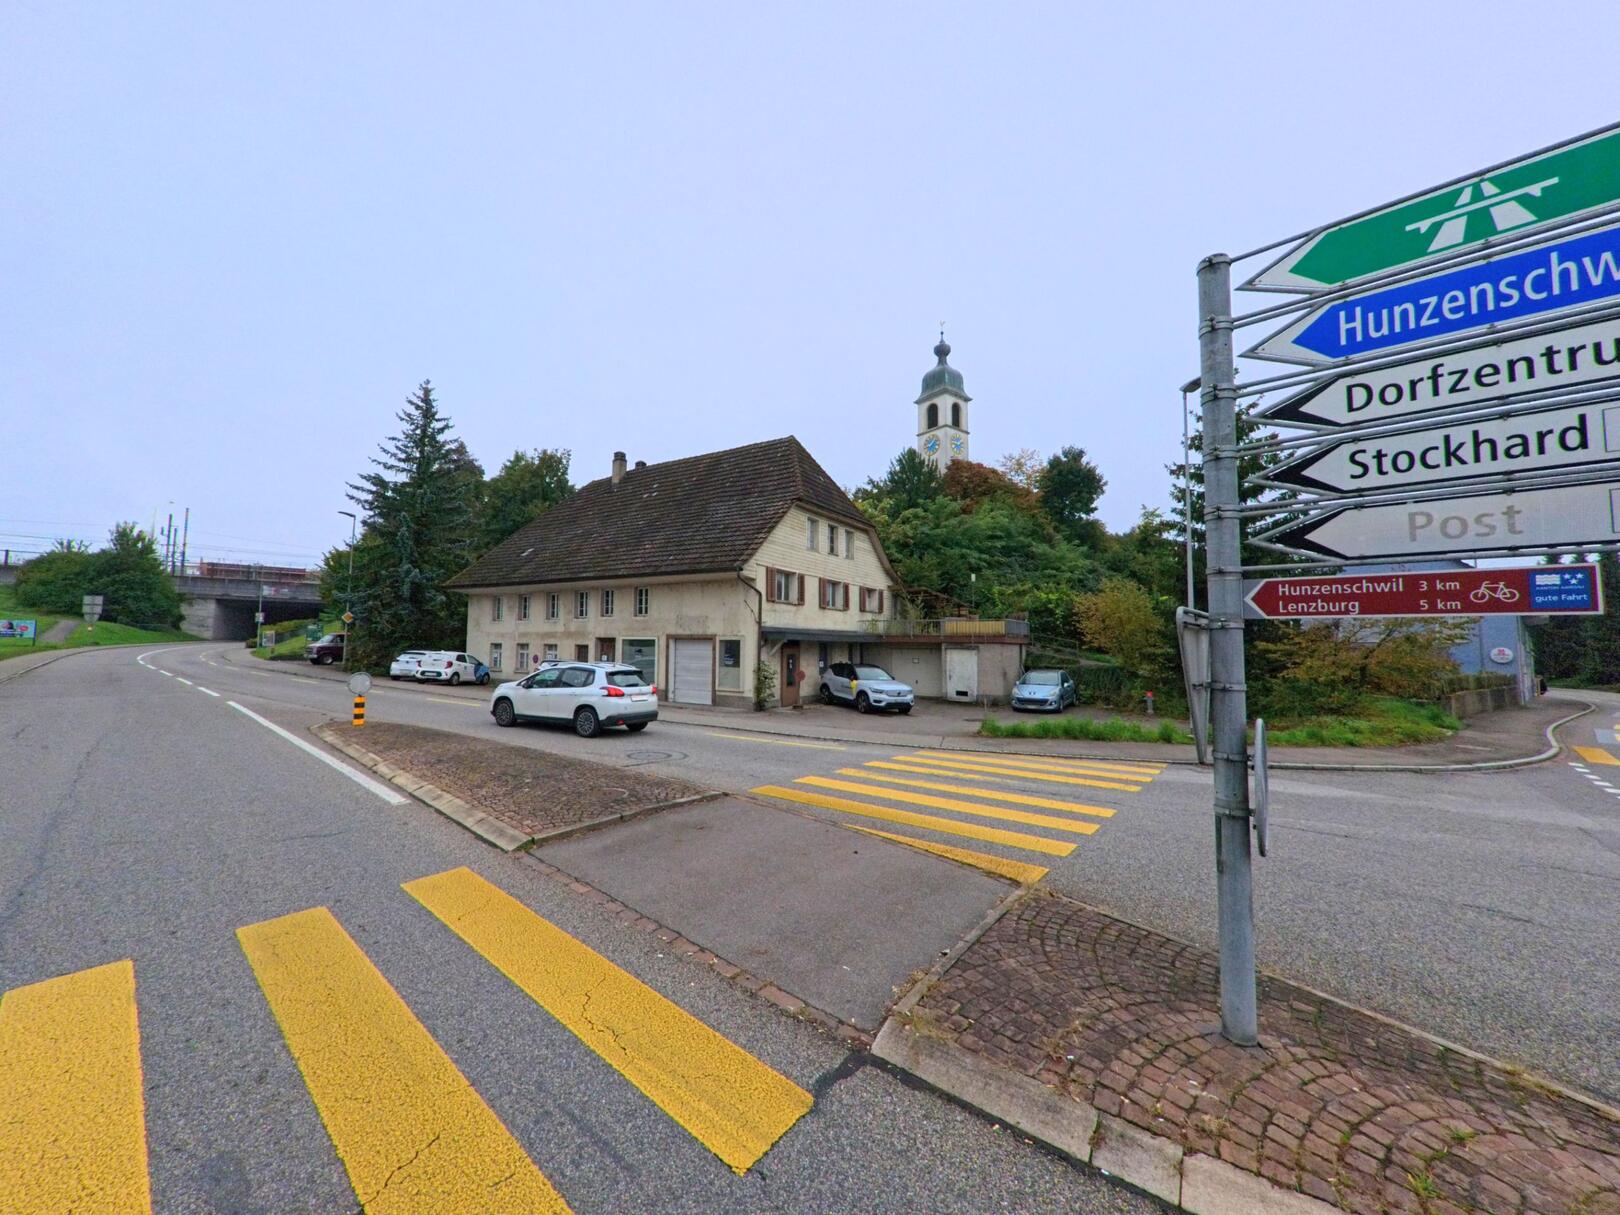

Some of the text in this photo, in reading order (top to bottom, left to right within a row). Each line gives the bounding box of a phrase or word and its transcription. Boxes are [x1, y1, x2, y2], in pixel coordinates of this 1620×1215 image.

[1346, 337, 1620, 413] Dorfzentru
[1348, 413, 1589, 480] Stockhard
[1407, 504, 1524, 542] Post
[1278, 578, 1460, 596] Hunzenschwil 3 km
[1535, 593, 1588, 603] gute Fahrt
[1279, 599, 1461, 615] Lenzburg 5 km
